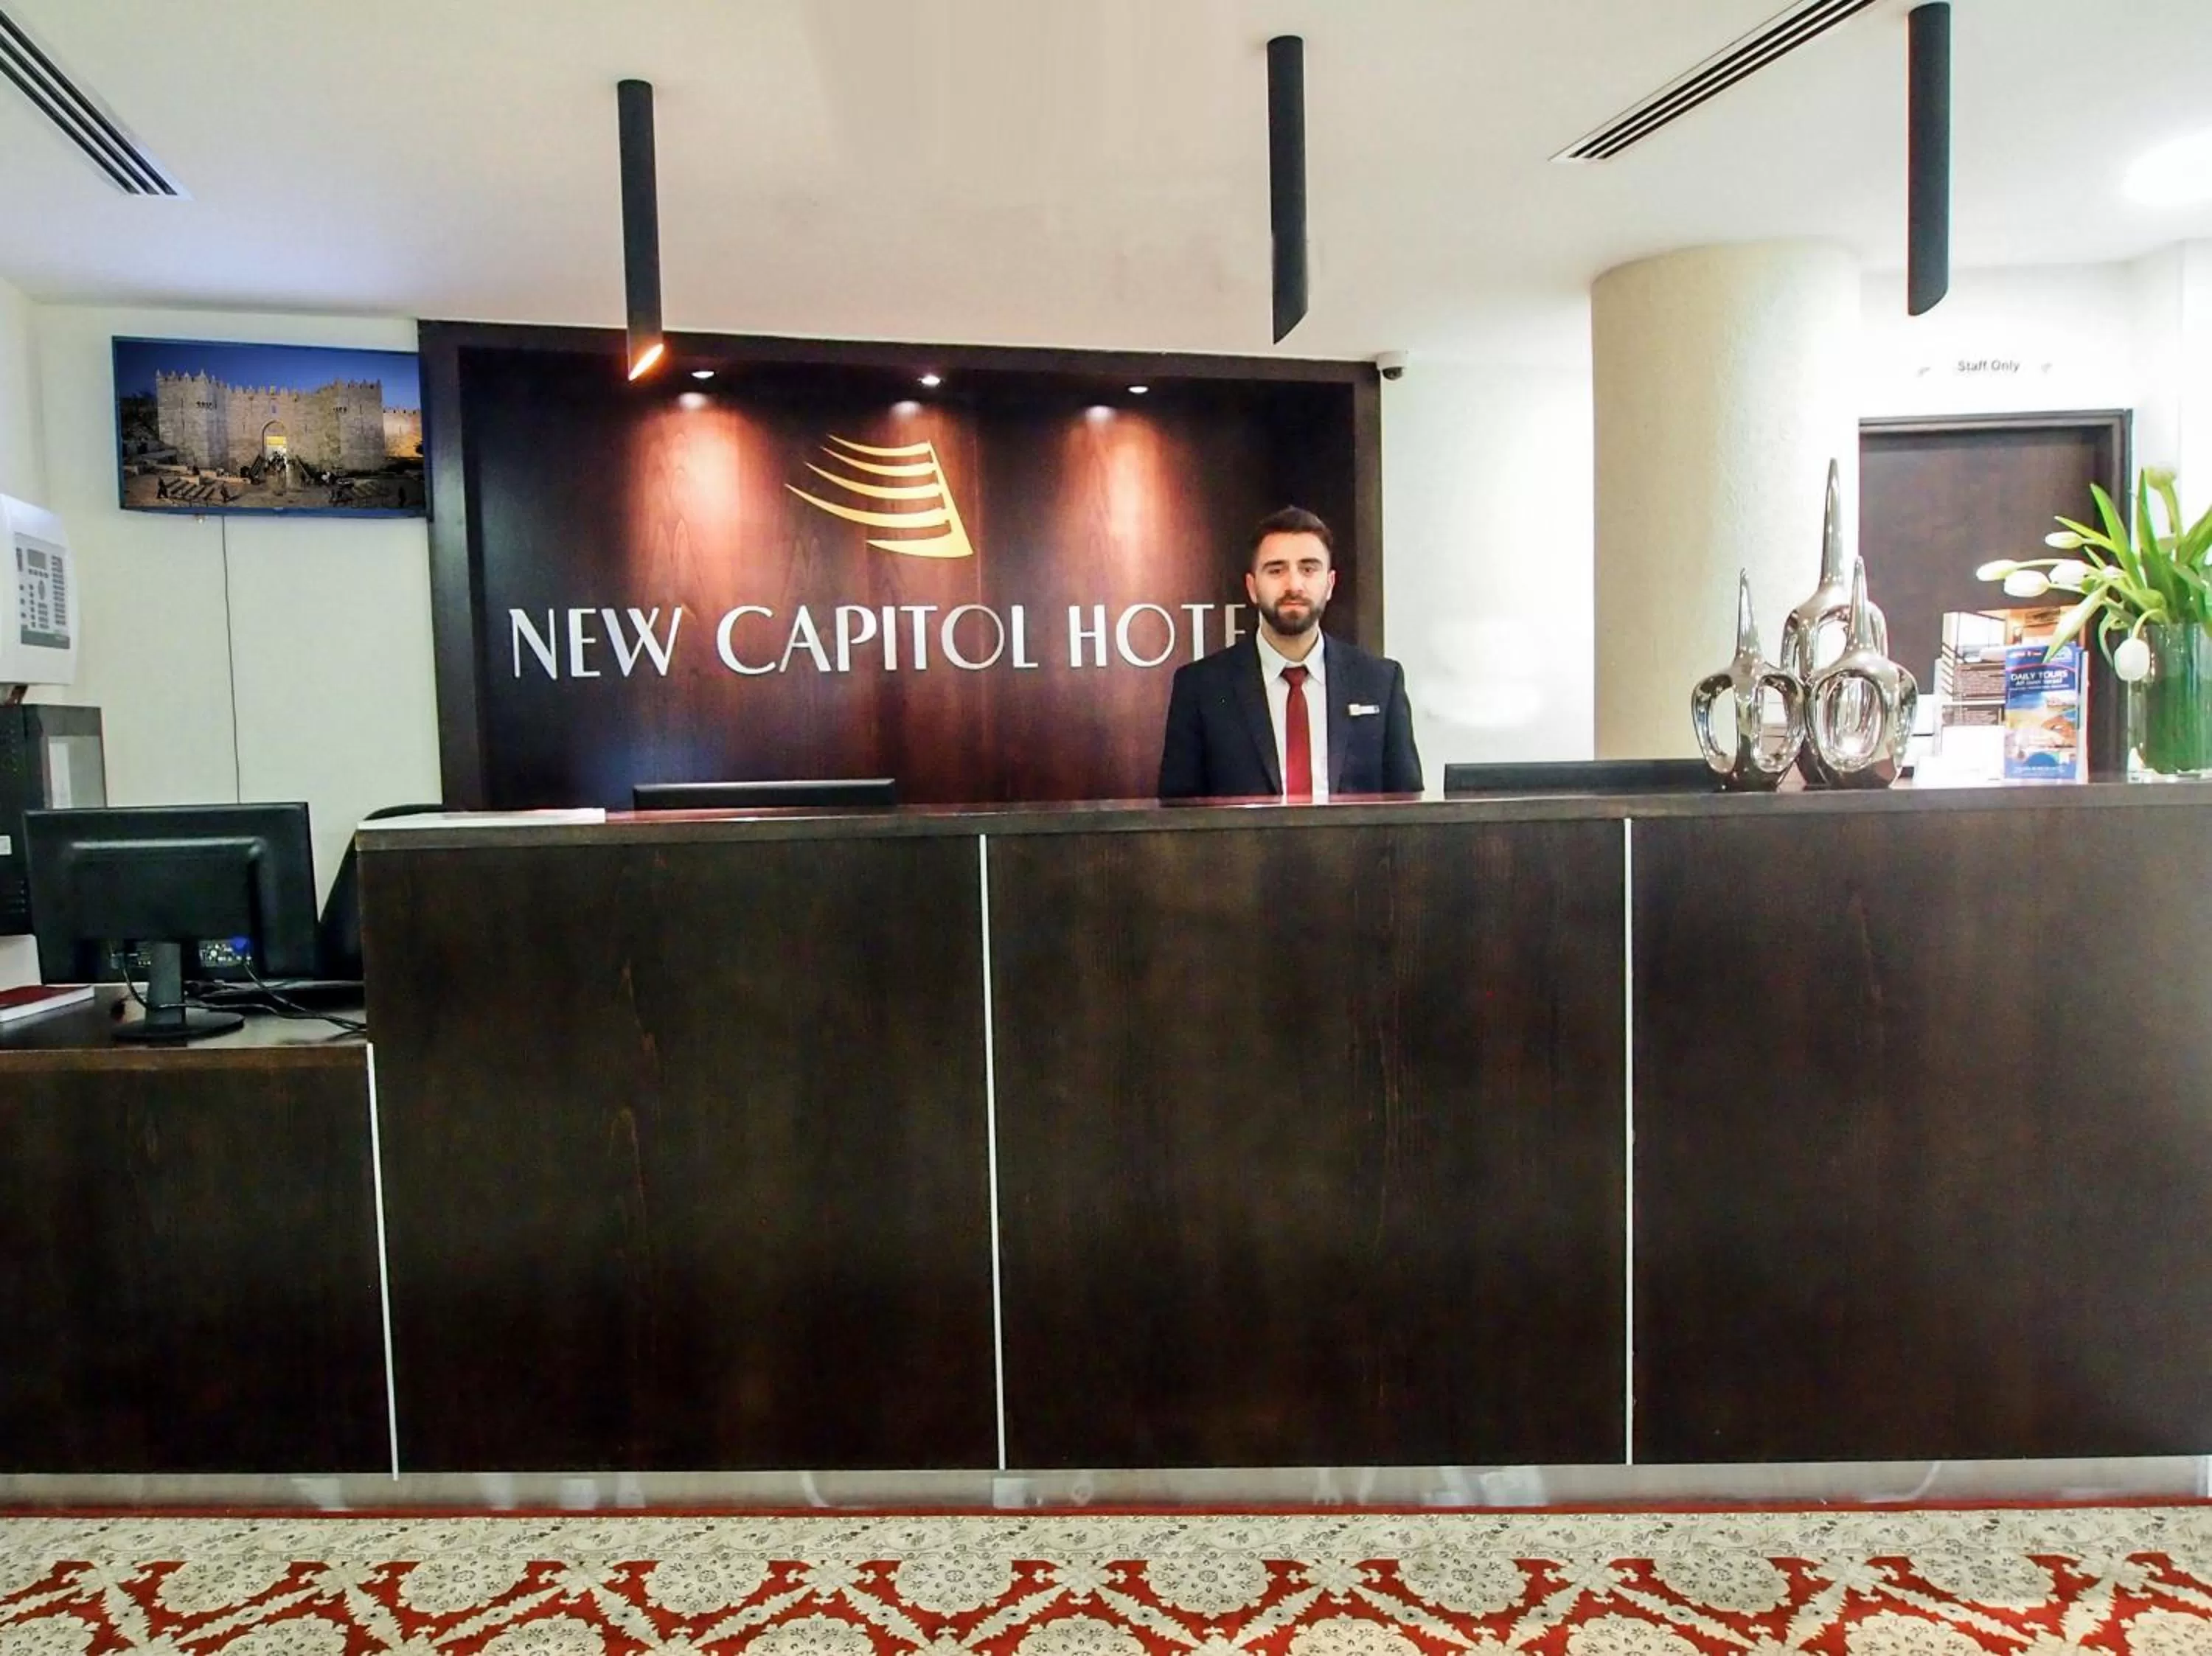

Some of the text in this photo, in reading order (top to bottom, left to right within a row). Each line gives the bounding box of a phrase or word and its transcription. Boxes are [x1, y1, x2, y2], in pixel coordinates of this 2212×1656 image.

[1958, 359, 2020, 374] Staff Only
[509, 603, 1248, 680] NEW CAPITOL HOTE
[2011, 669, 2068, 681] DAILY TOURS
